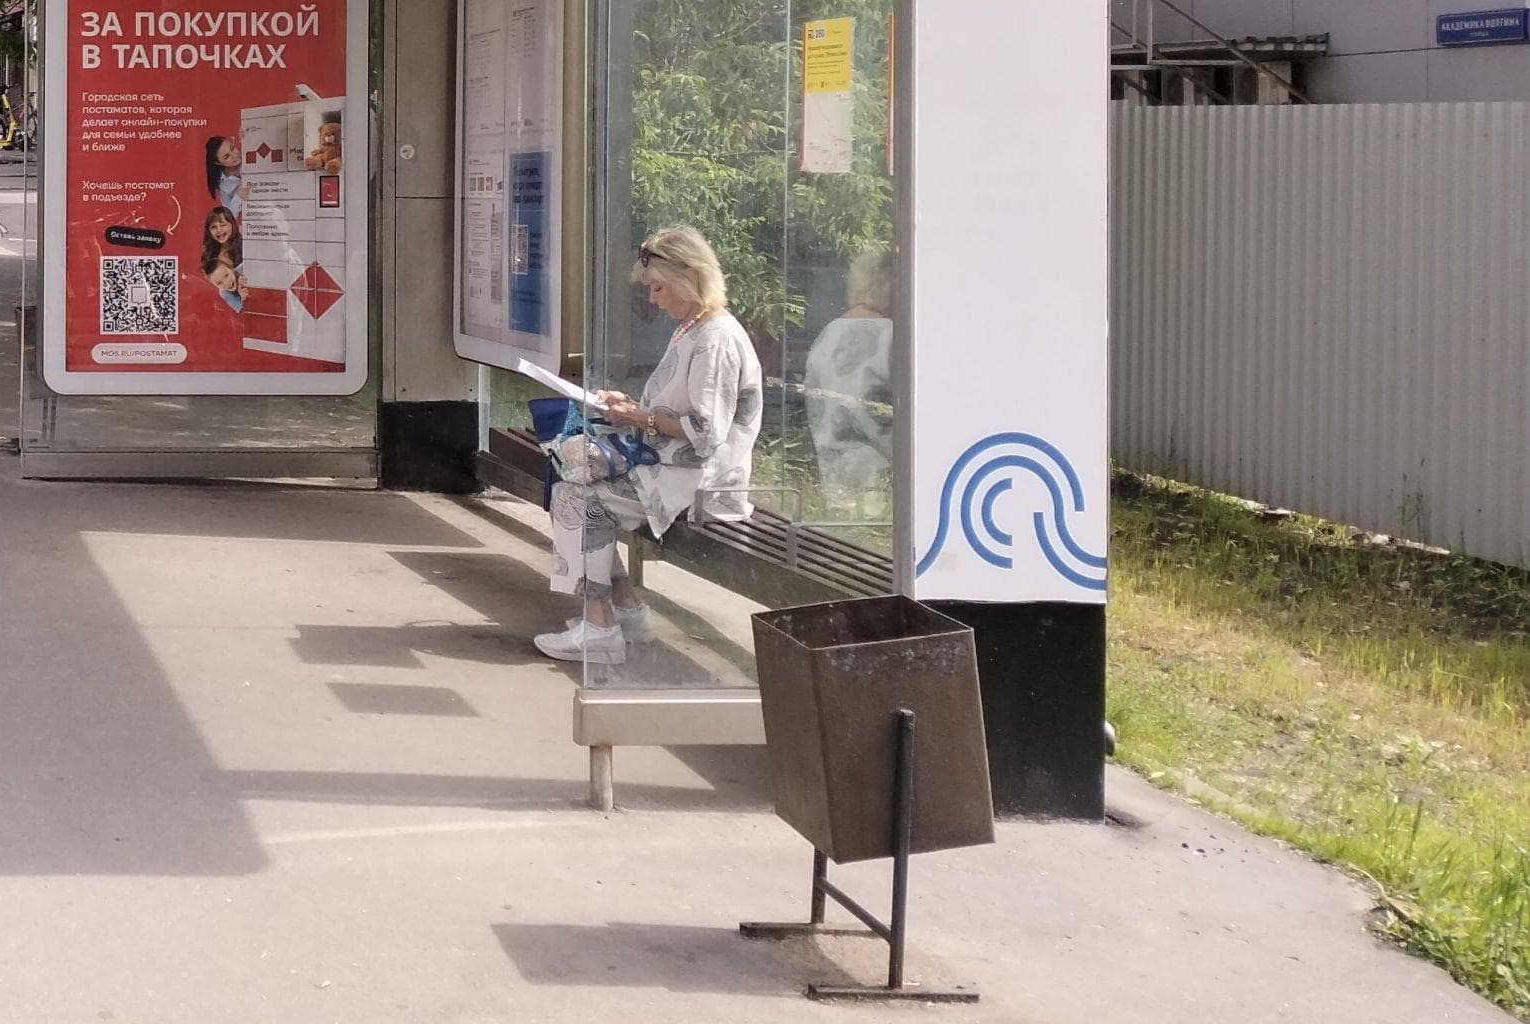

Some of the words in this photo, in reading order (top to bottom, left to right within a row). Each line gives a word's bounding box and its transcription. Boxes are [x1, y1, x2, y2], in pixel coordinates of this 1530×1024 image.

[81, 11, 123, 37] ЗА
[135, 4, 319, 37] ПОКУПКОЙ
[82, 44, 101, 69] В
[112, 44, 287, 69] ТАПОЧКАХ
[82, 92, 138, 103] Городская
[140, 93, 165, 102] сеть
[82, 106, 147, 115] постаматов,
[150, 106, 193, 116] которая
[82, 119, 119, 127] делает
[121, 117, 207, 128] онлайн-покупки
[82, 131, 101, 140] для
[103, 131, 136, 139] семьи
[138, 129, 182, 140] удобнее
[82, 144, 89, 152] и
[92, 142, 126, 152] ближе
[82, 180, 123, 190] Хочешь
[125, 181, 175, 190] постамат
[82, 194, 89, 202] в
[91, 191, 147, 203] подъезде?
